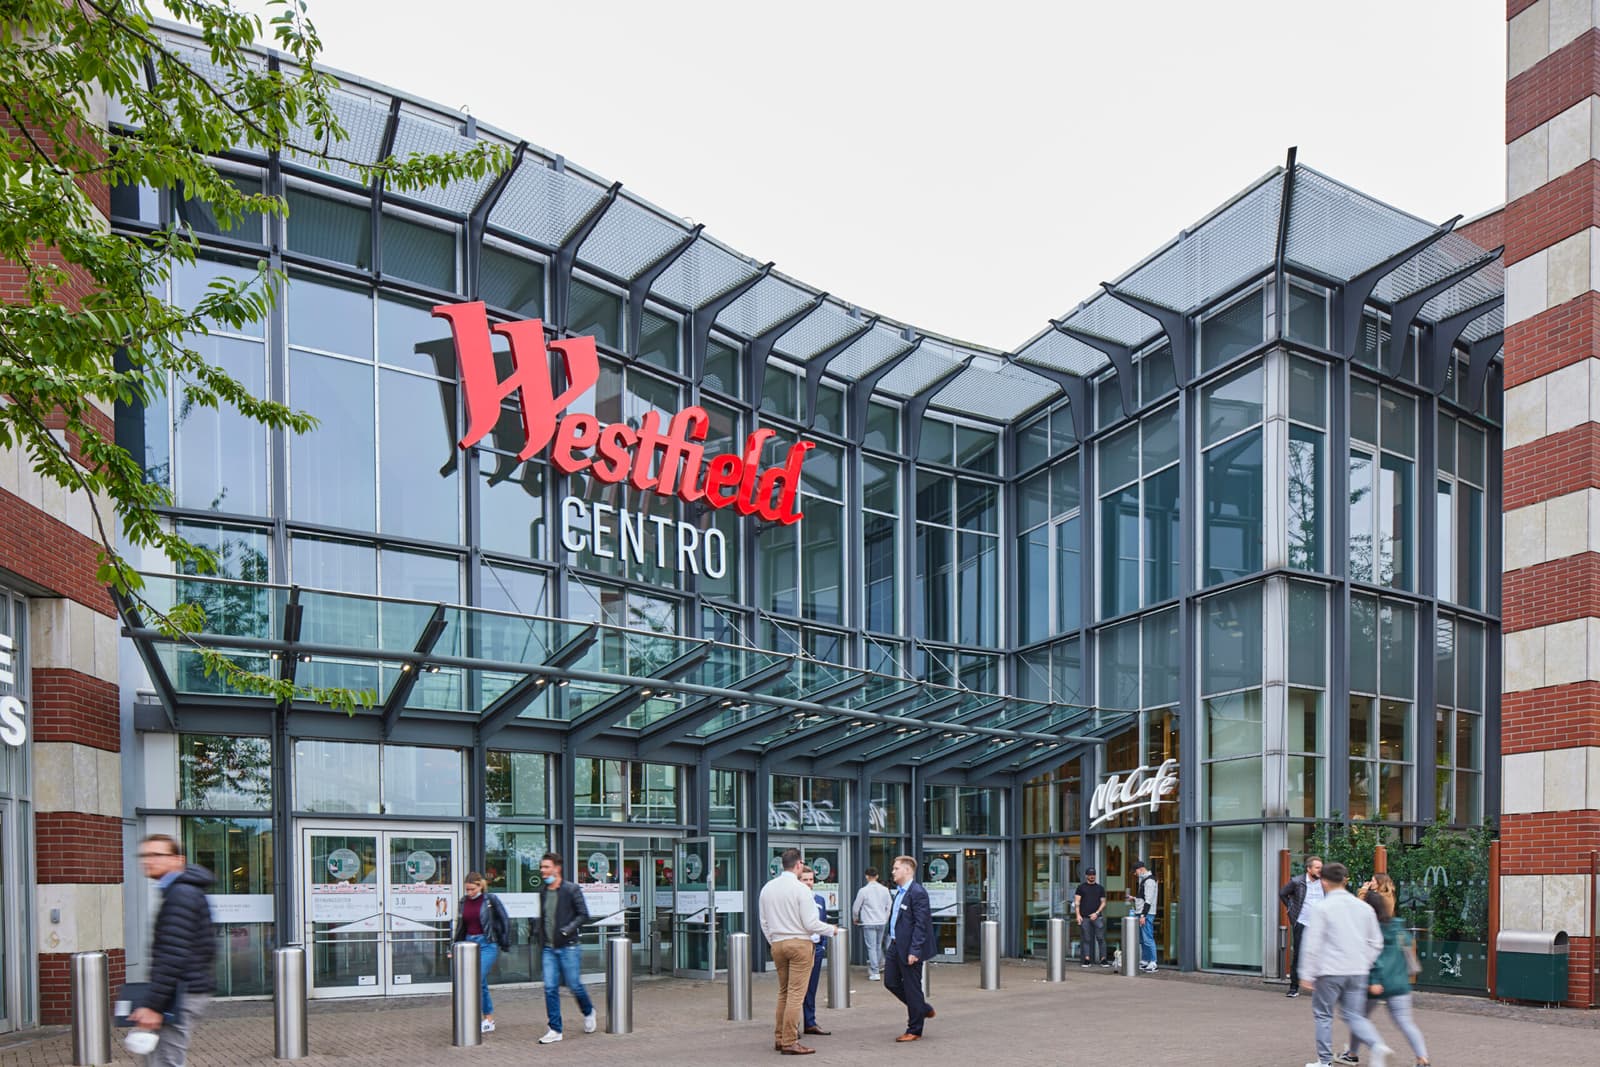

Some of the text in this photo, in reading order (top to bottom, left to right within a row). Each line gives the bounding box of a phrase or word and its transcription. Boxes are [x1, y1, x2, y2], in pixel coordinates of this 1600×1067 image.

[431, 301, 816, 526] Westfield
[561, 496, 726, 579] CENTRO
[1089, 758, 1178, 820] McCafé
